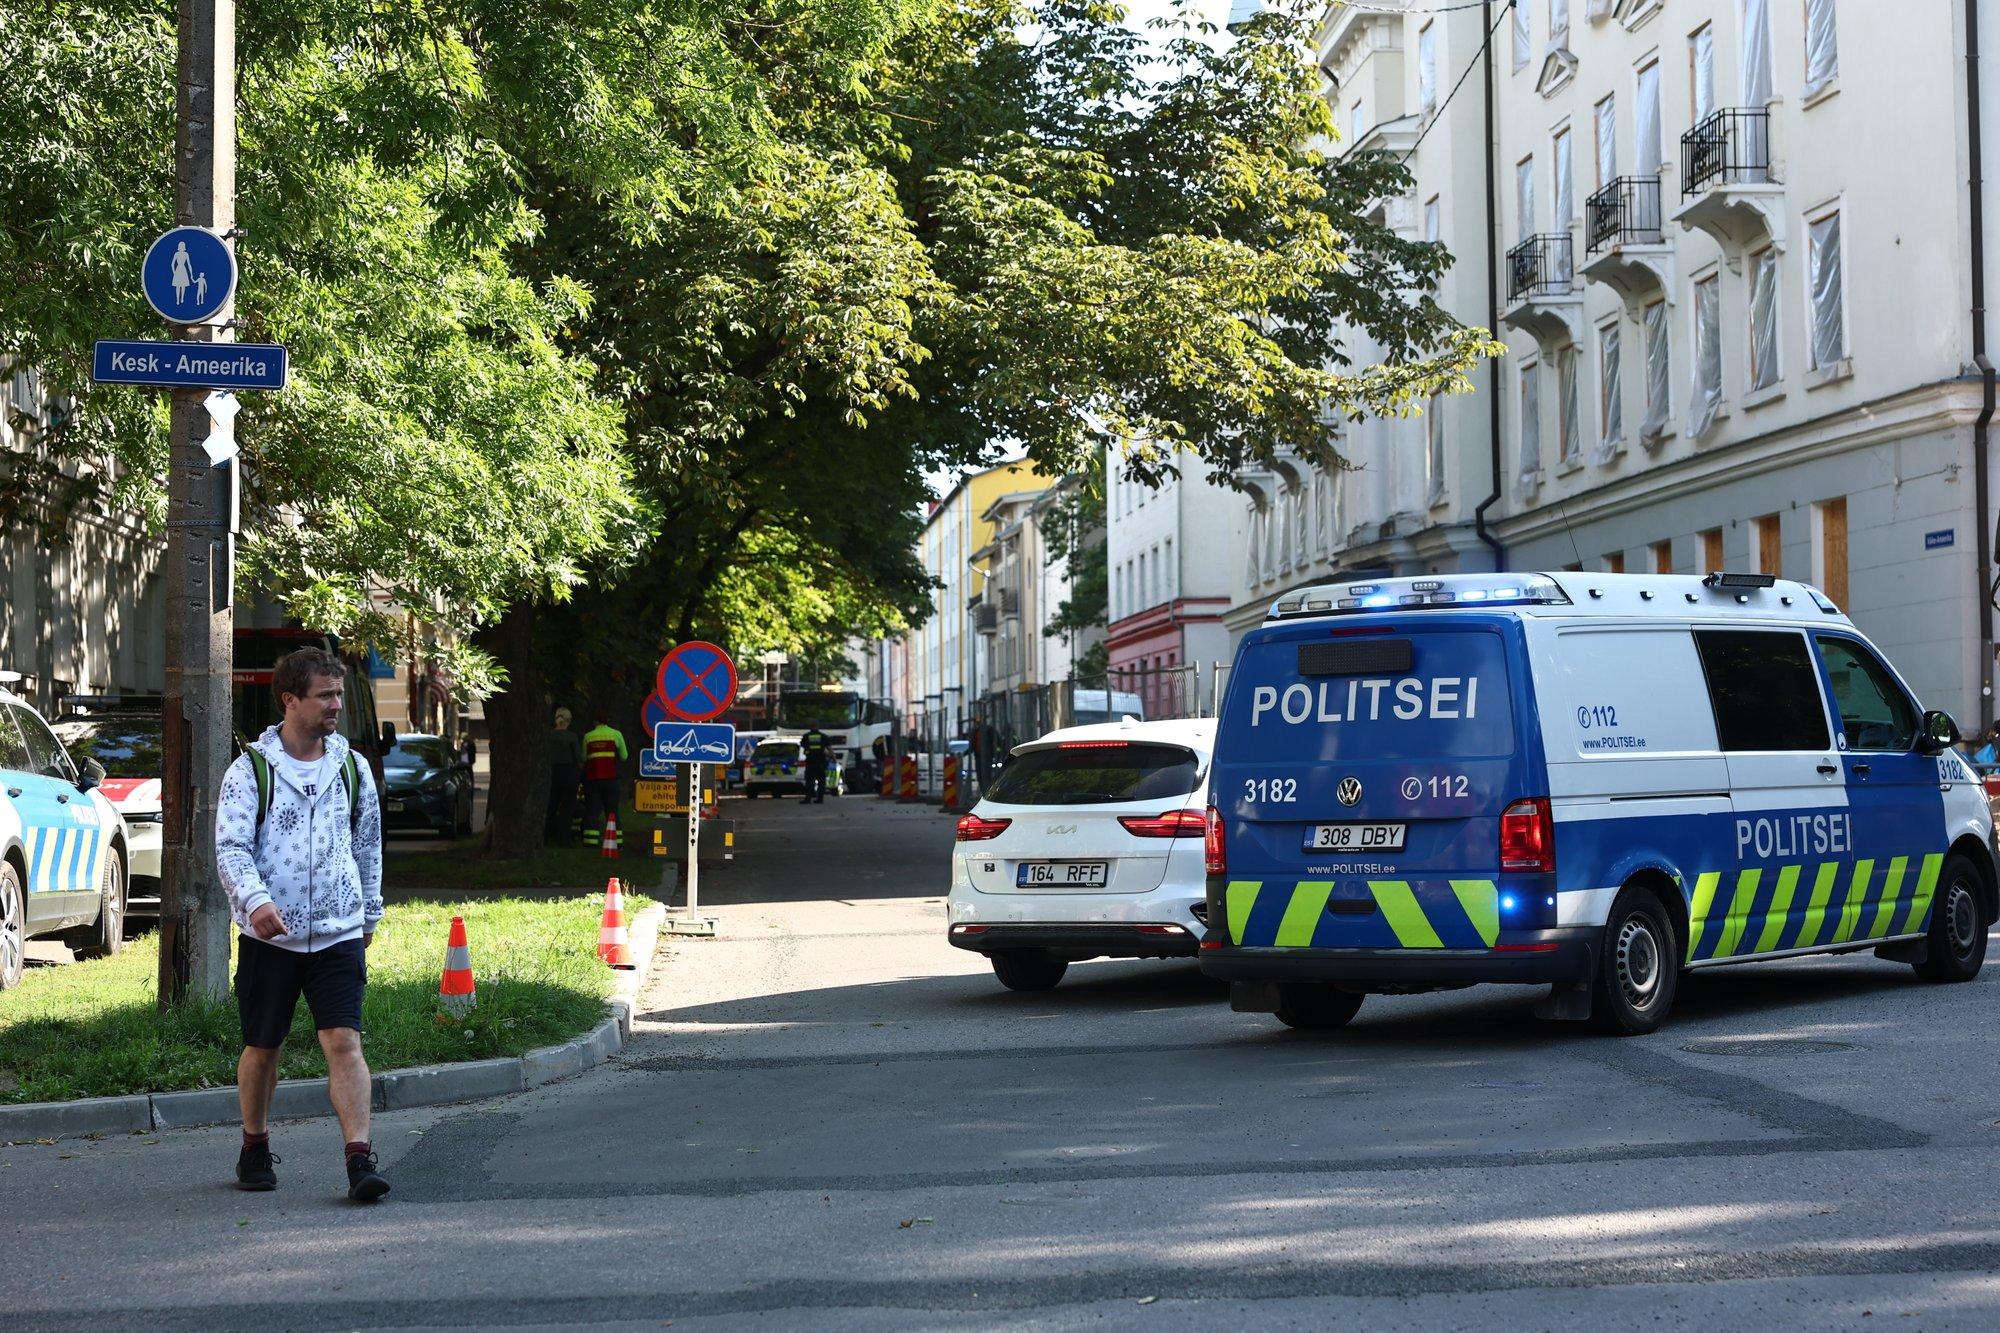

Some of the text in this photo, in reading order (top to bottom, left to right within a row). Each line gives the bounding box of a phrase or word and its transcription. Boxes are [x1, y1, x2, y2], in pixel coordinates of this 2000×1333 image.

[111, 352, 159, 373] Kesk
[175, 354, 267, 377] Ameerika
[1251, 677, 1478, 727] POLITSEI
[1592, 705, 1618, 727] 112
[1582, 736, 1646, 749] www.POLITSEI.ee
[1939, 759, 1964, 780] 3182
[652, 792, 675, 800] ehitu
[1244, 778, 1297, 803] 3182
[1427, 775, 1469, 798] 112
[1320, 828, 1352, 846] 308
[1361, 827, 1400, 846] DBY
[1736, 813, 1851, 860] POLITSEI
[1030, 866, 1054, 882] 164
[1066, 866, 1102, 882] RFF
[1307, 863, 1396, 874] www.POLITSEI.ee
